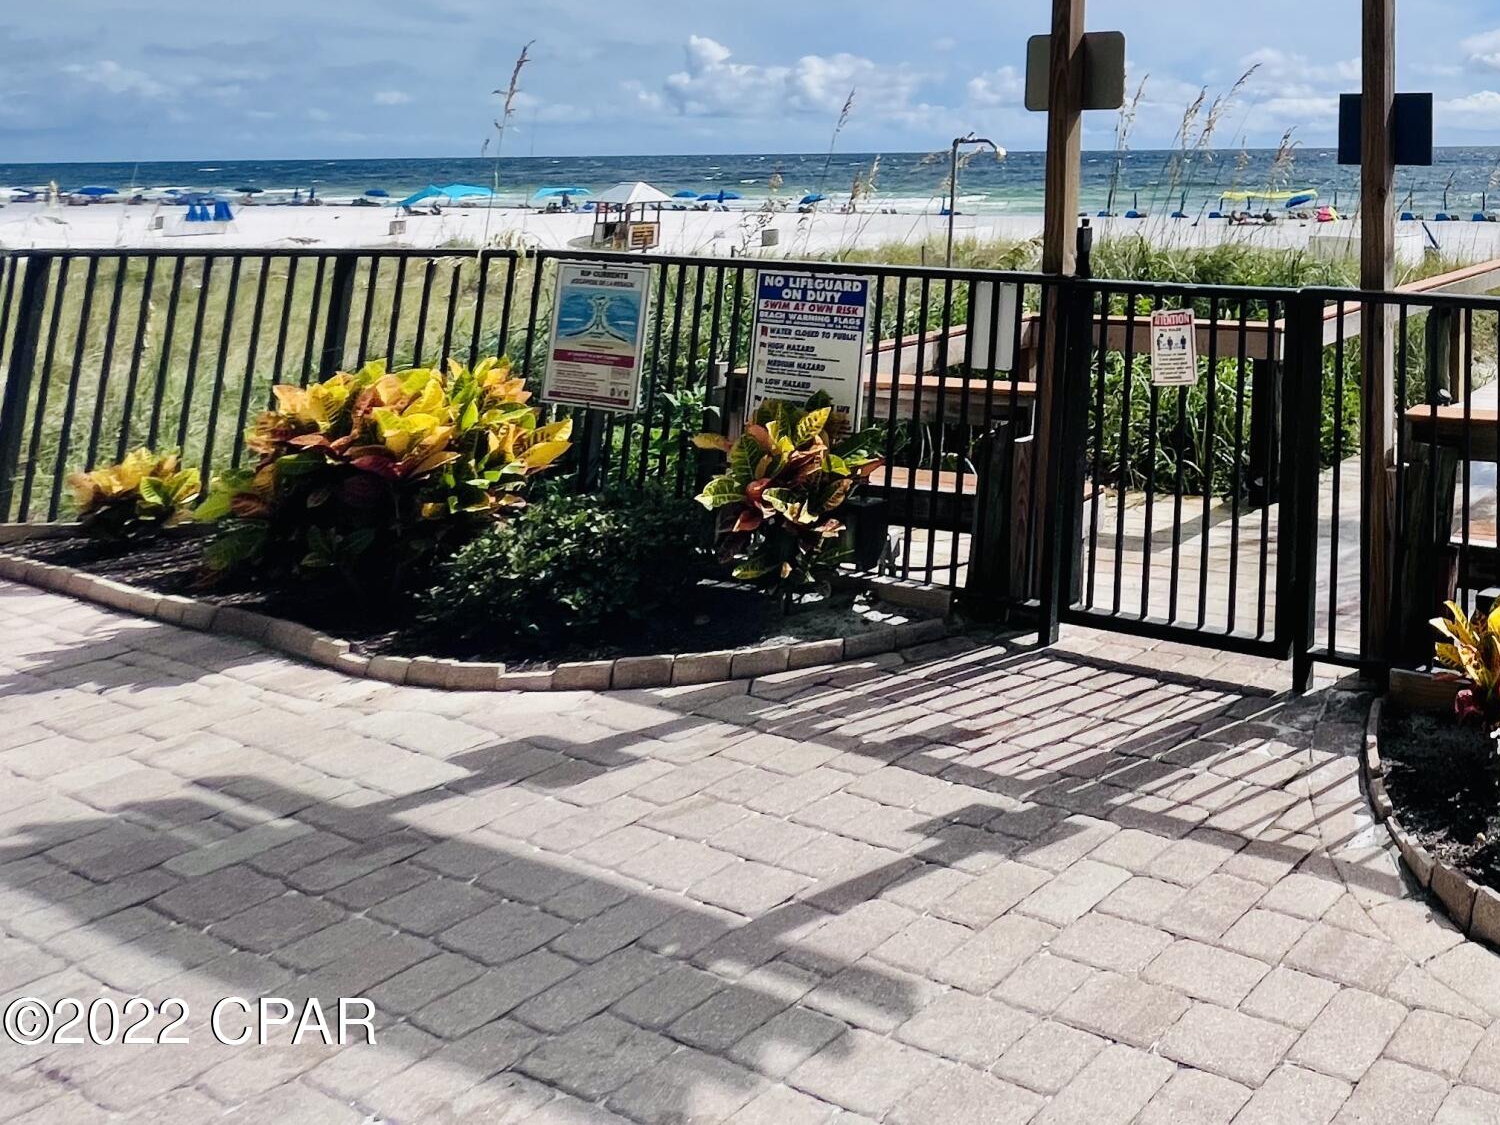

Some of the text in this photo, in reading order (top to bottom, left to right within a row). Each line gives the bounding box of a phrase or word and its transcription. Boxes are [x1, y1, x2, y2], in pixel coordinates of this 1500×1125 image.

[764, 275, 862, 292] NO LIFEGUARD
[781, 288, 842, 303] ON DUTY
[763, 300, 859, 315] SWIM AT OWN RISK
[759, 311, 785, 319] BEACH
[788, 313, 831, 322] WARNING
[833, 317, 860, 325] FLAGS
[769, 326, 792, 335] WATER
[821, 331, 831, 339] TO
[786, 344, 815, 353] HAZARD
[796, 362, 826, 371] HAZARD
[765, 377, 811, 389] LOW HAZARD
